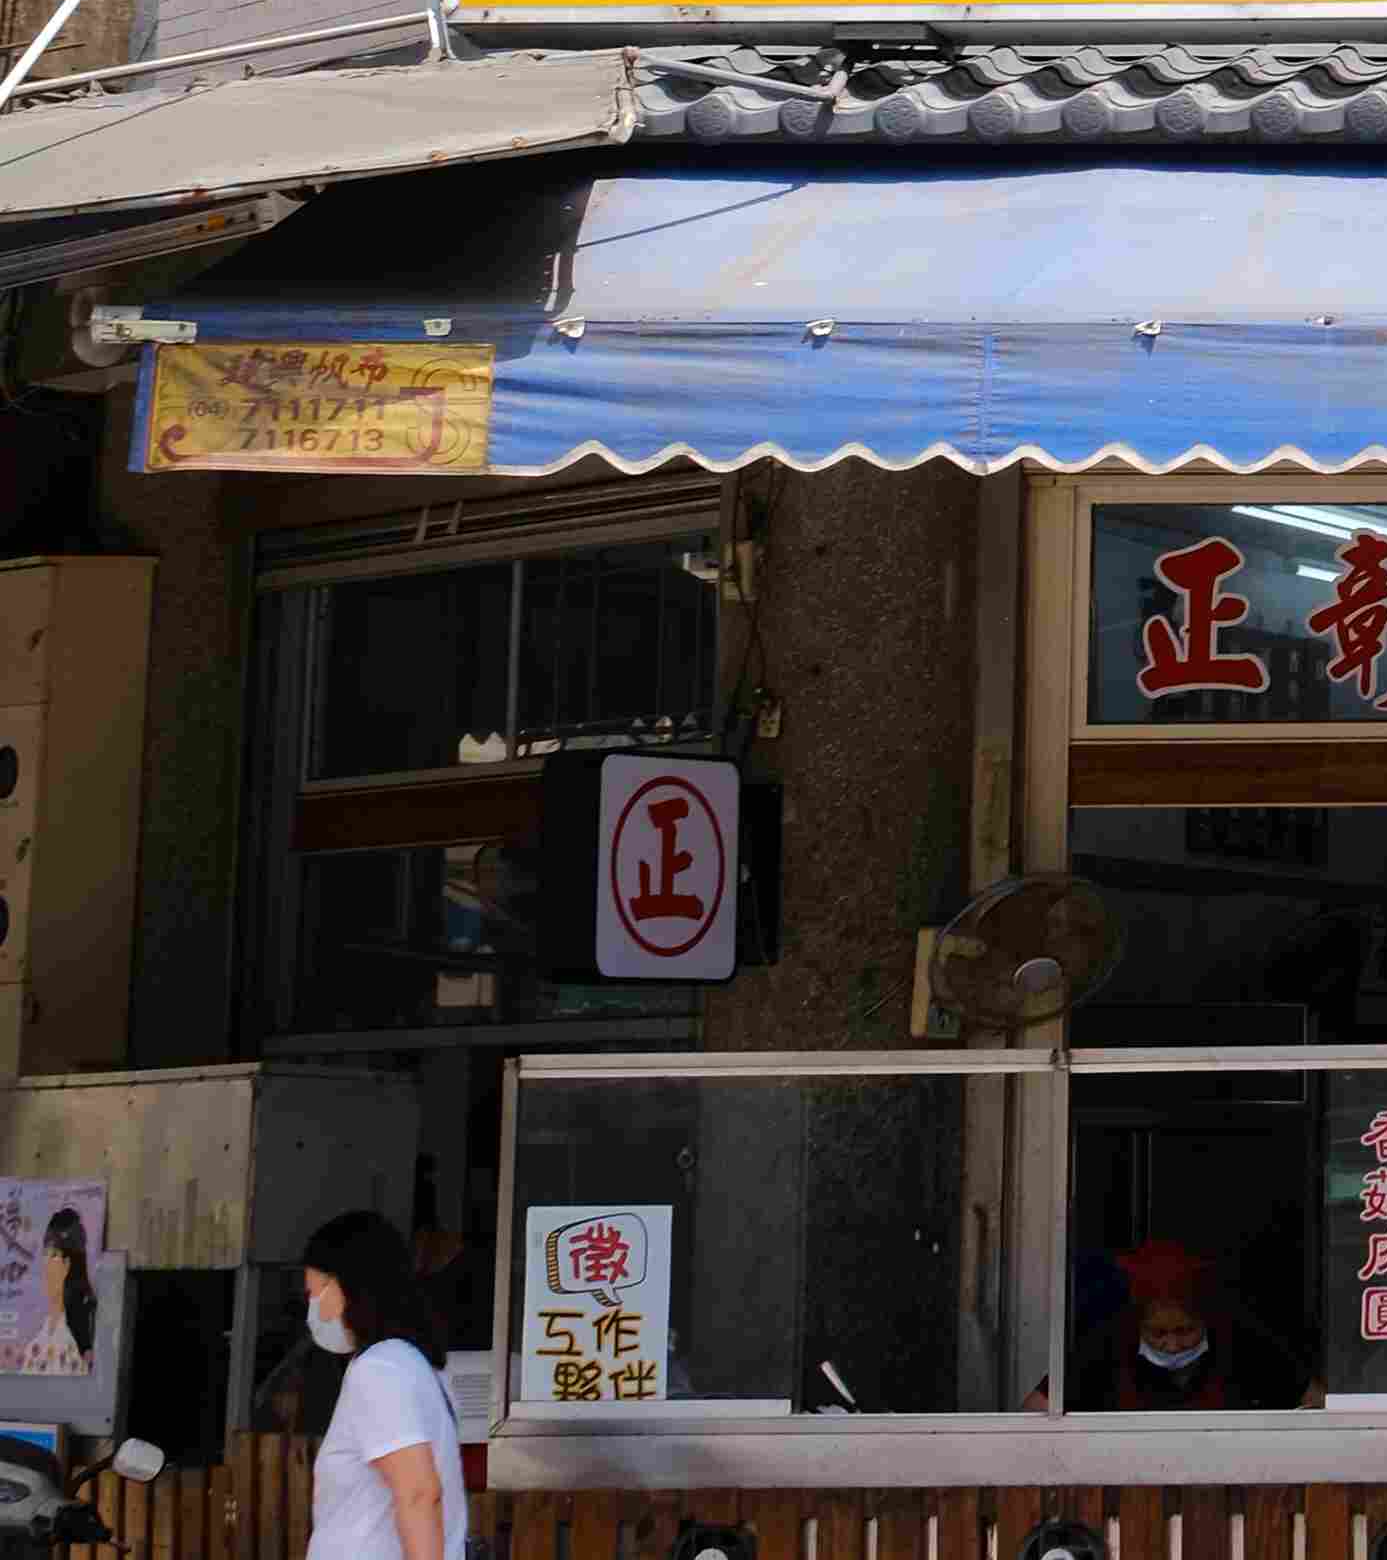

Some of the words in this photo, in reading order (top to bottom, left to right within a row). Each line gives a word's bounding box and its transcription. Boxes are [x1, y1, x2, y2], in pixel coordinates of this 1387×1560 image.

[239, 428, 386, 453] 7116713
[631, 797, 705, 923] 正
[569, 1221, 630, 1284] 徵
